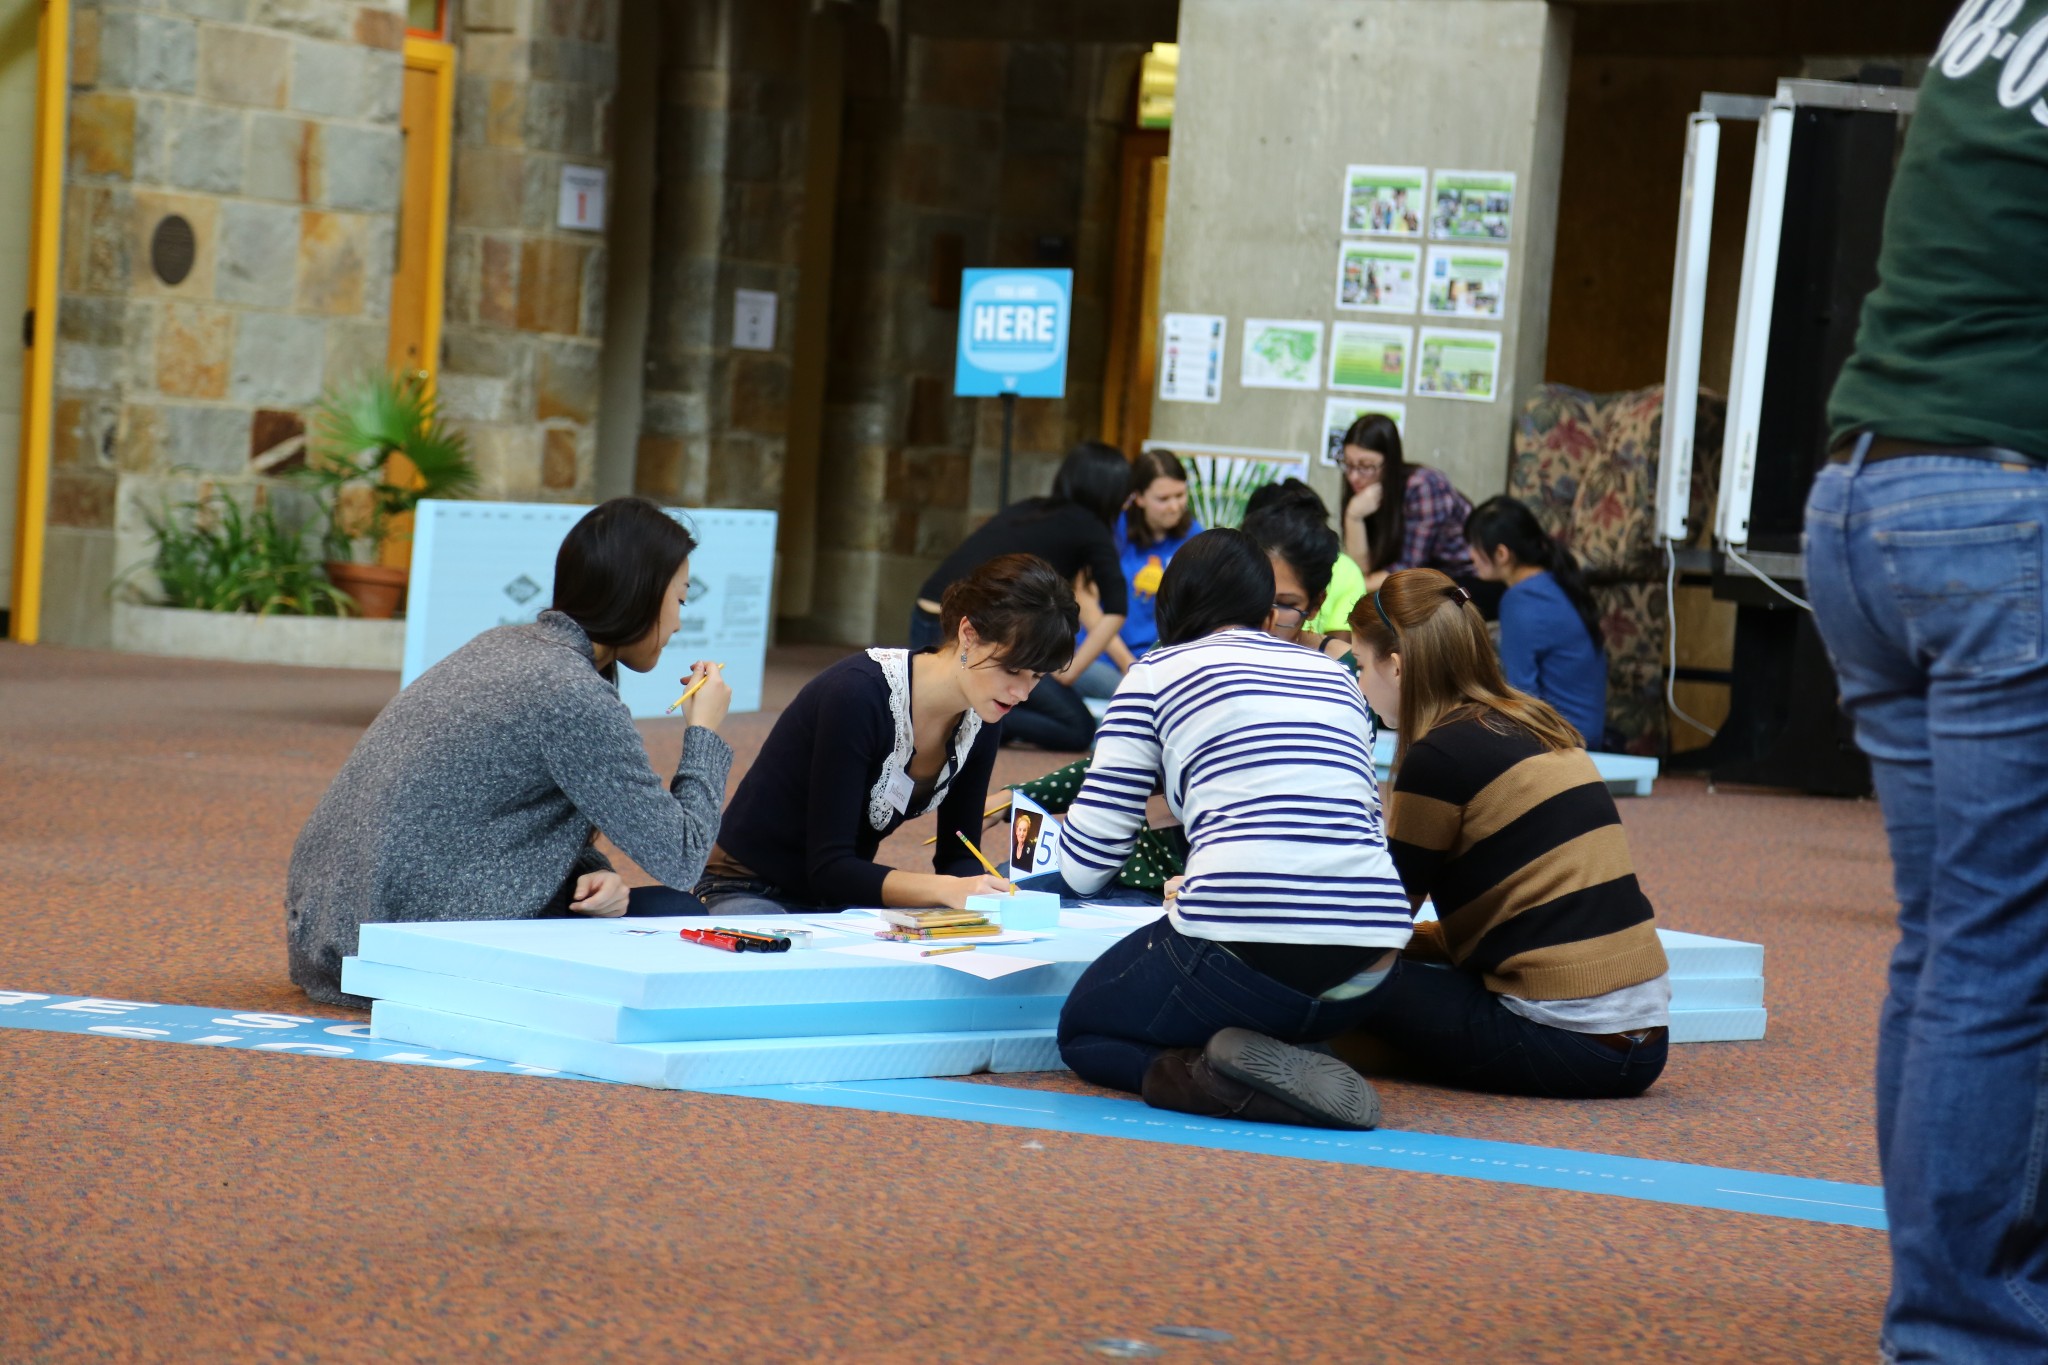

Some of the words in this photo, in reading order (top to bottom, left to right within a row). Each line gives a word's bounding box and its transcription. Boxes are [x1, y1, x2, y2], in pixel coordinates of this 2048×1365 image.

[974, 304, 1056, 342] HERE
[1036, 830, 1060, 866] 5
[1101, 1113, 1656, 1184] new.wellesley.edu/youarehere
